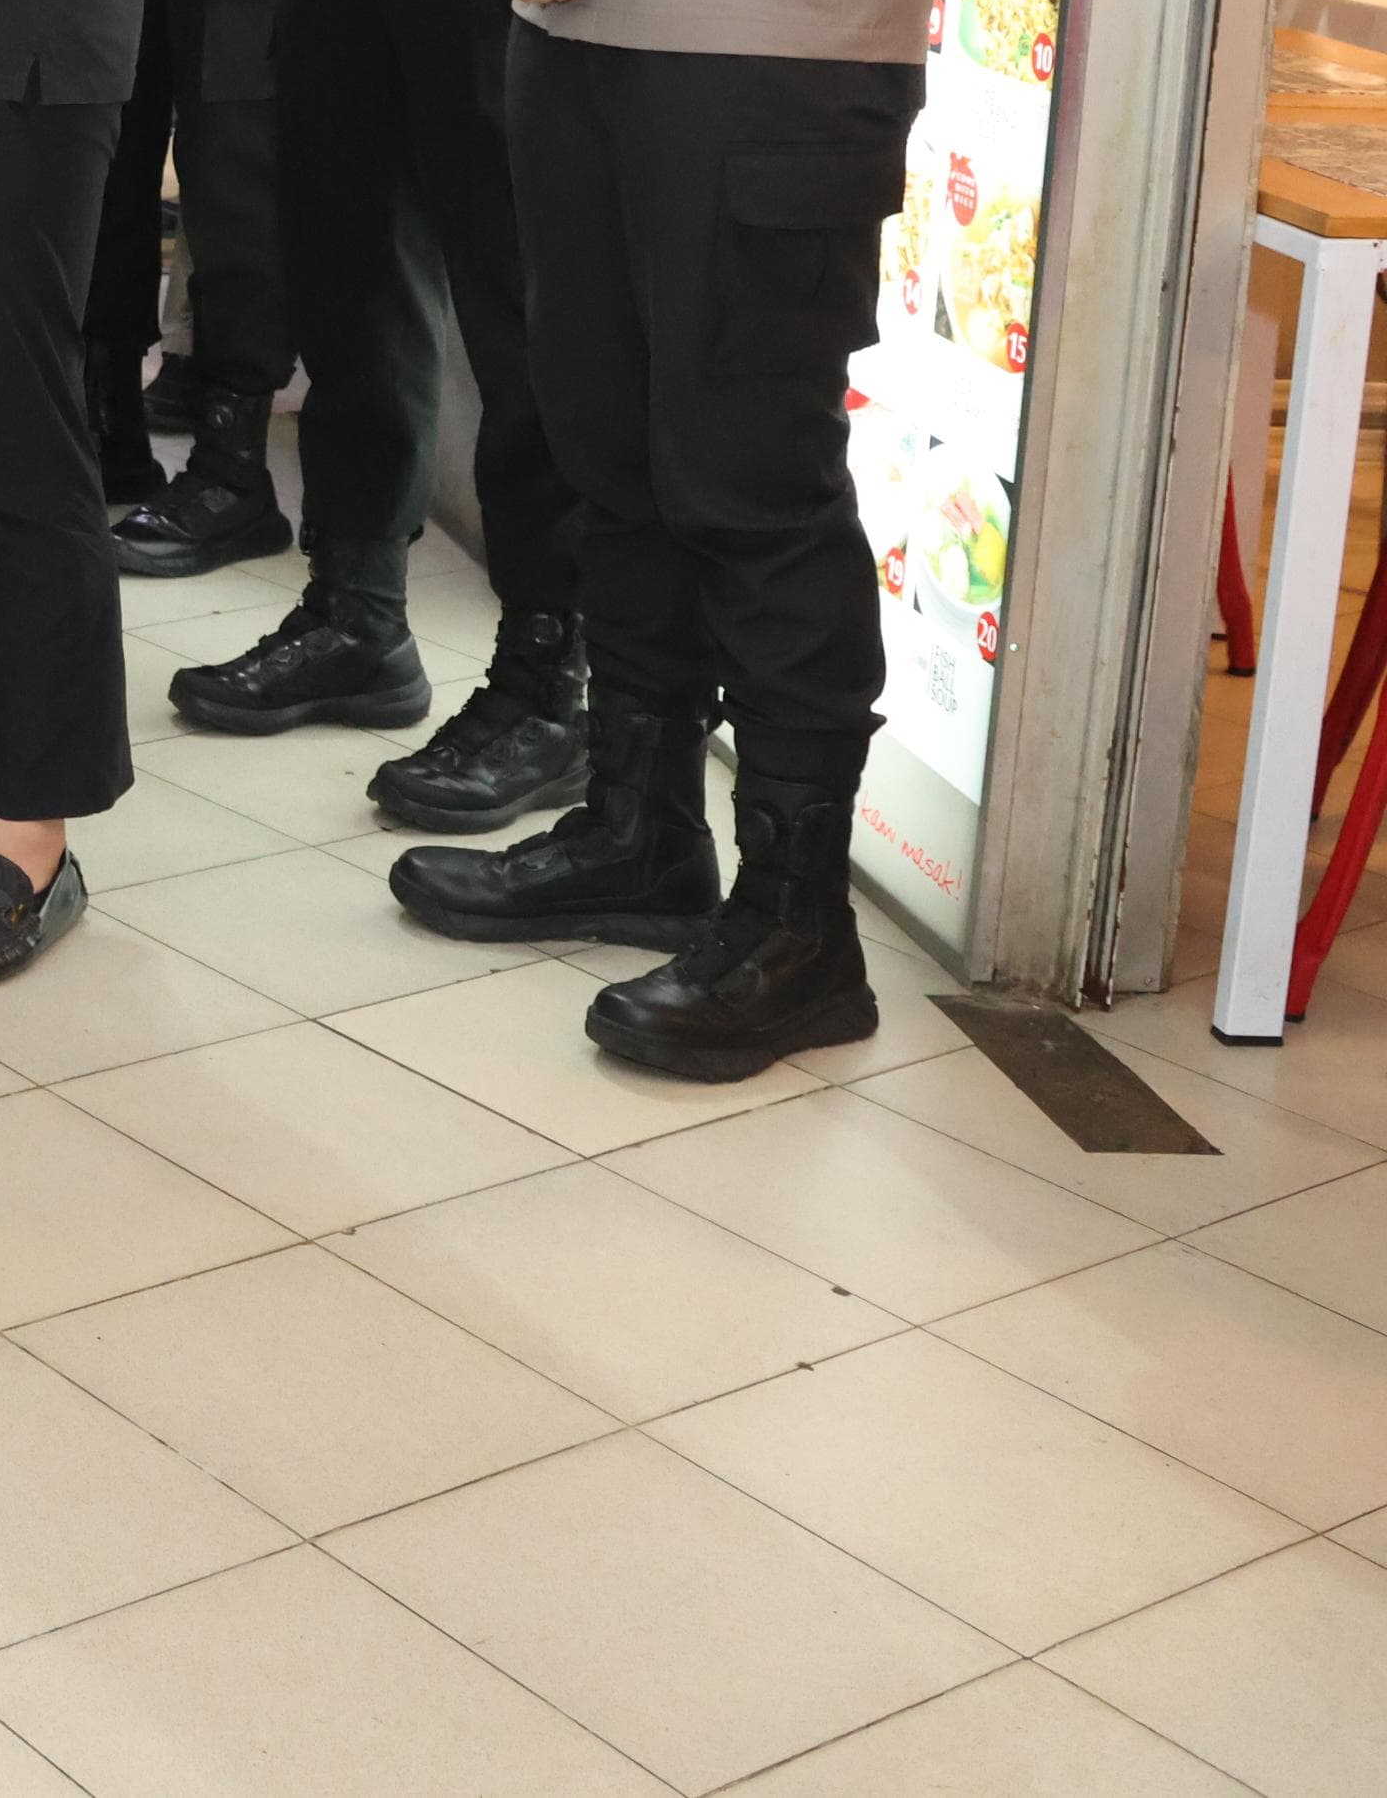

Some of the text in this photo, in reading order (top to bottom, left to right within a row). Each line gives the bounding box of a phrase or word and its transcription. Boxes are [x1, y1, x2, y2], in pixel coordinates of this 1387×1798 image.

[928, 7, 941, 35] 9
[1034, 43, 1054, 73] 10
[1009, 332, 1028, 364] 15
[888, 555, 904, 587] 19
[978, 618, 998, 653] 20
